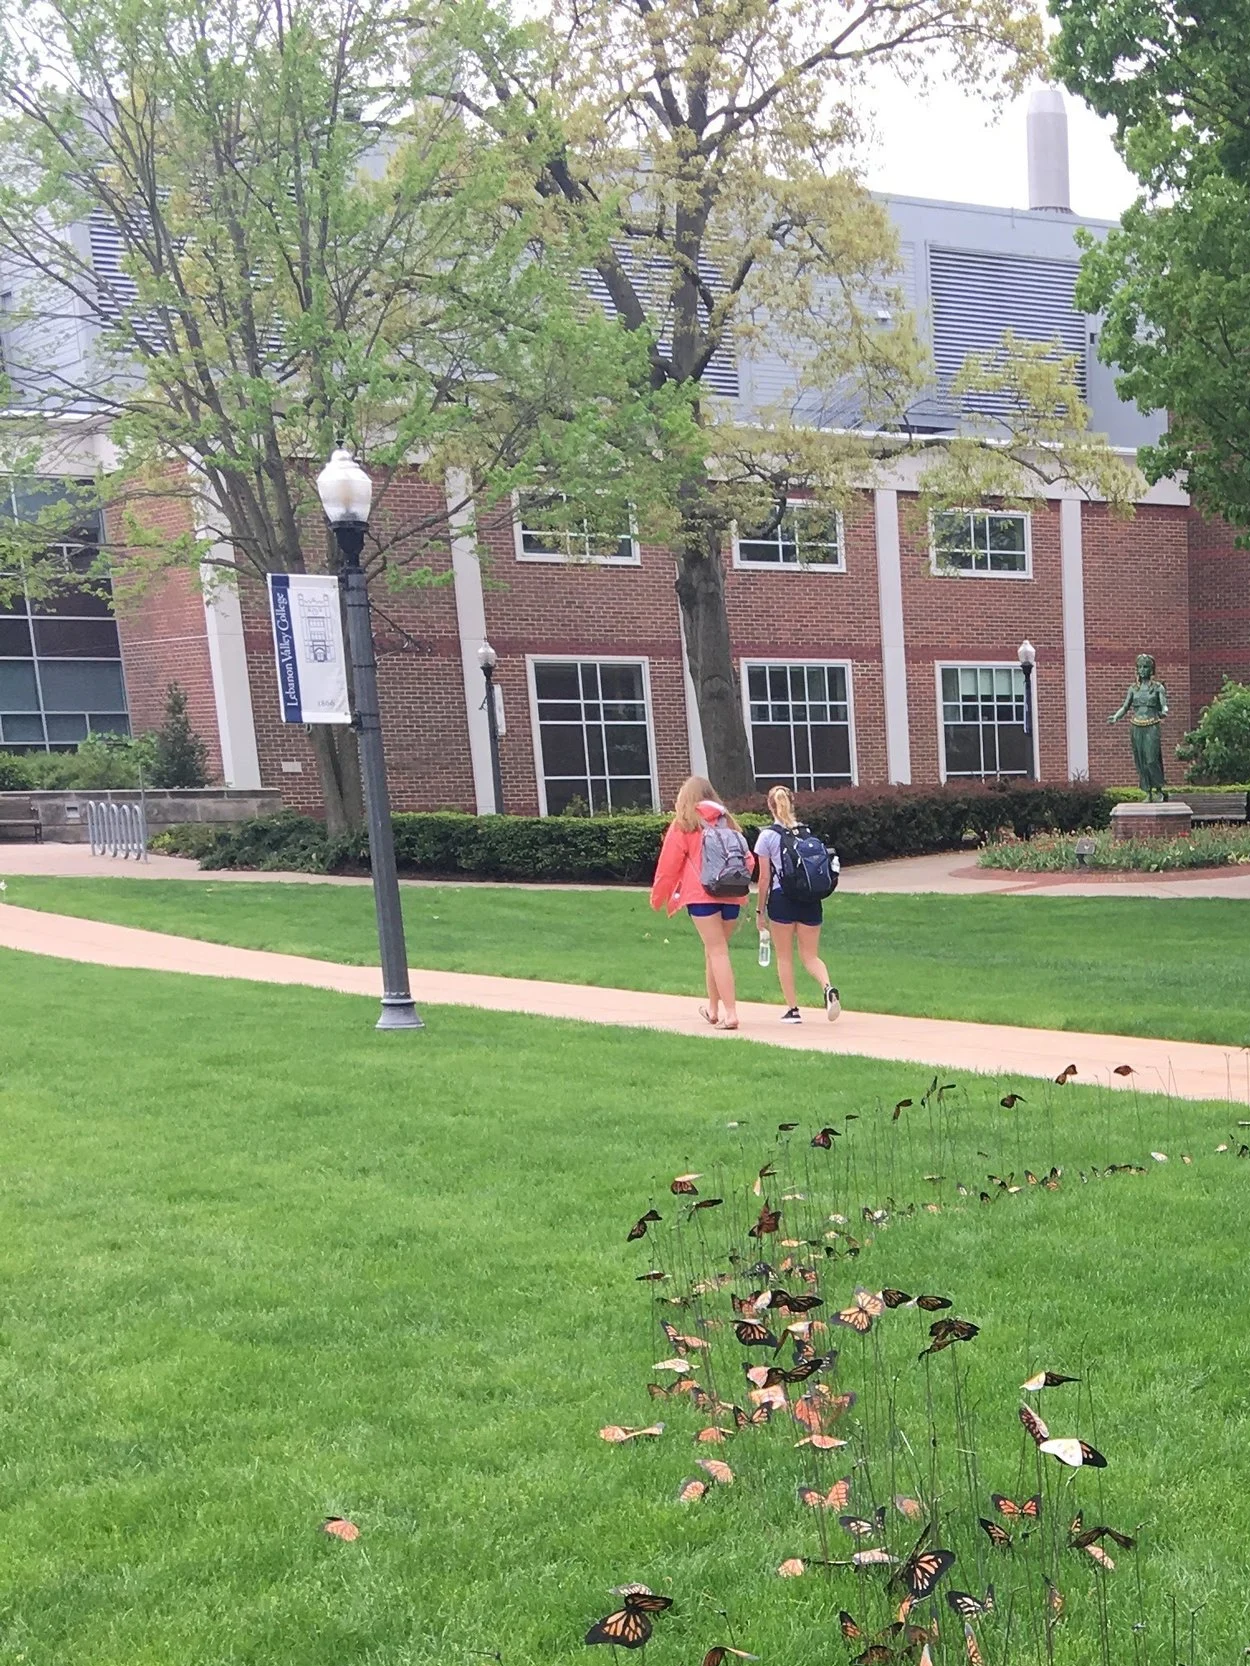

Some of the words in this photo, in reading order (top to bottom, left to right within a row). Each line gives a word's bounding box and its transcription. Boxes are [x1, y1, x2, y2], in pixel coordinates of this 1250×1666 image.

[276, 593, 288, 631] College
[281, 633, 292, 663] Valley
[285, 664, 298, 707] Lebanon
